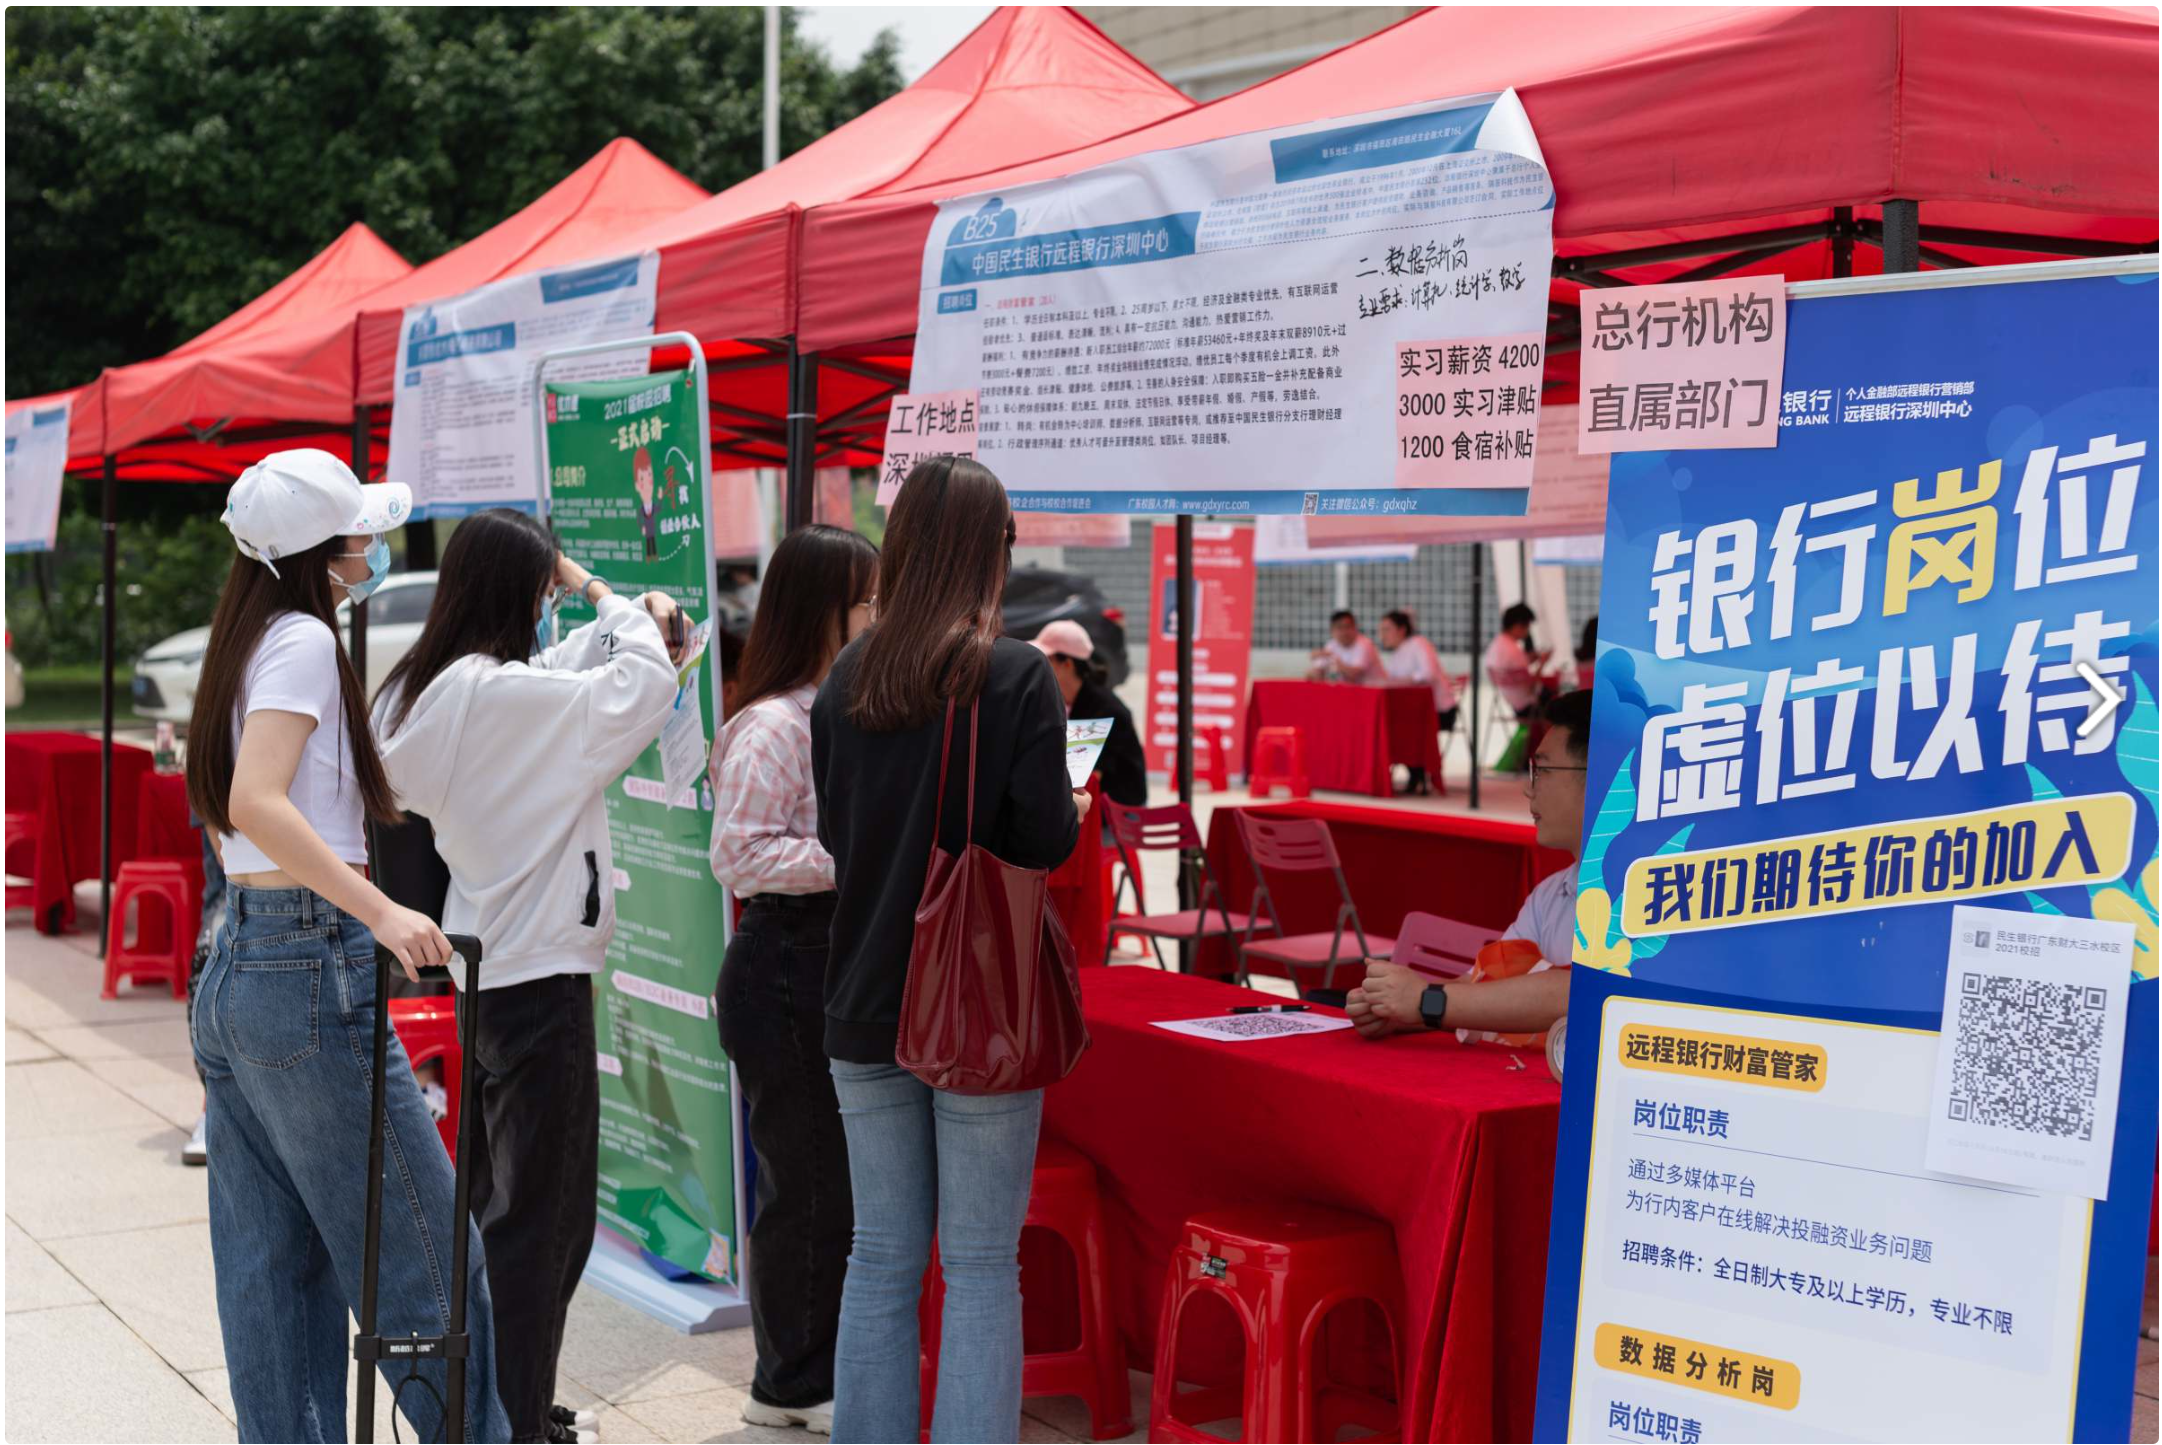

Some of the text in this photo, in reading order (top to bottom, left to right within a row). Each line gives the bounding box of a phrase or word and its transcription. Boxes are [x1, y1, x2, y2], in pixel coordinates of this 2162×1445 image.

[963, 214, 999, 241] B25
[971, 228, 1169, 276] 中国民生银行远程银行深圳中心
[1592, 292, 1774, 352] 总行机构
[1400, 343, 1540, 378] 实习薪资 4200
[1399, 384, 1536, 418] 3000 实习津贴
[1588, 378, 1769, 434] 直属部门
[1780, 389, 1832, 413] 银行
[1846, 381, 1975, 401] 个人金融部远程银行营销部
[891, 398, 976, 436] 工作地点
[1796, 414, 1829, 426] BANK
[1844, 400, 1973, 423] 远程银行深圳中心
[1401, 428, 1534, 461] 1200 食宿补贴
[1182, 499, 1250, 513] www.gdxyrc.com
[1321, 499, 1380, 511] 关注微信公众号：
[1648, 433, 2147, 660] 银行岗位
[1636, 610, 2132, 822] 虚位以待
[1645, 811, 2101, 925] 我们期待你的加入
[1996, 943, 2041, 957] 2021校招
[1997, 931, 2121, 953] 民生银行广东财大三水校区
[1626, 1032, 1819, 1082] 远程银行财富管家
[1632, 1099, 1730, 1139] 岗位职责
[1628, 1158, 1756, 1198] 通过多媒体平台
[1625, 1190, 1933, 1264] 为行内客户在线解决投融资业务问题
[1622, 1239, 2014, 1336] 招聘条件：全日制大专及以上学历，专业不限
[1619, 1335, 1775, 1396] 数据分析岗
[1608, 1401, 1702, 1444] 岗位职责
